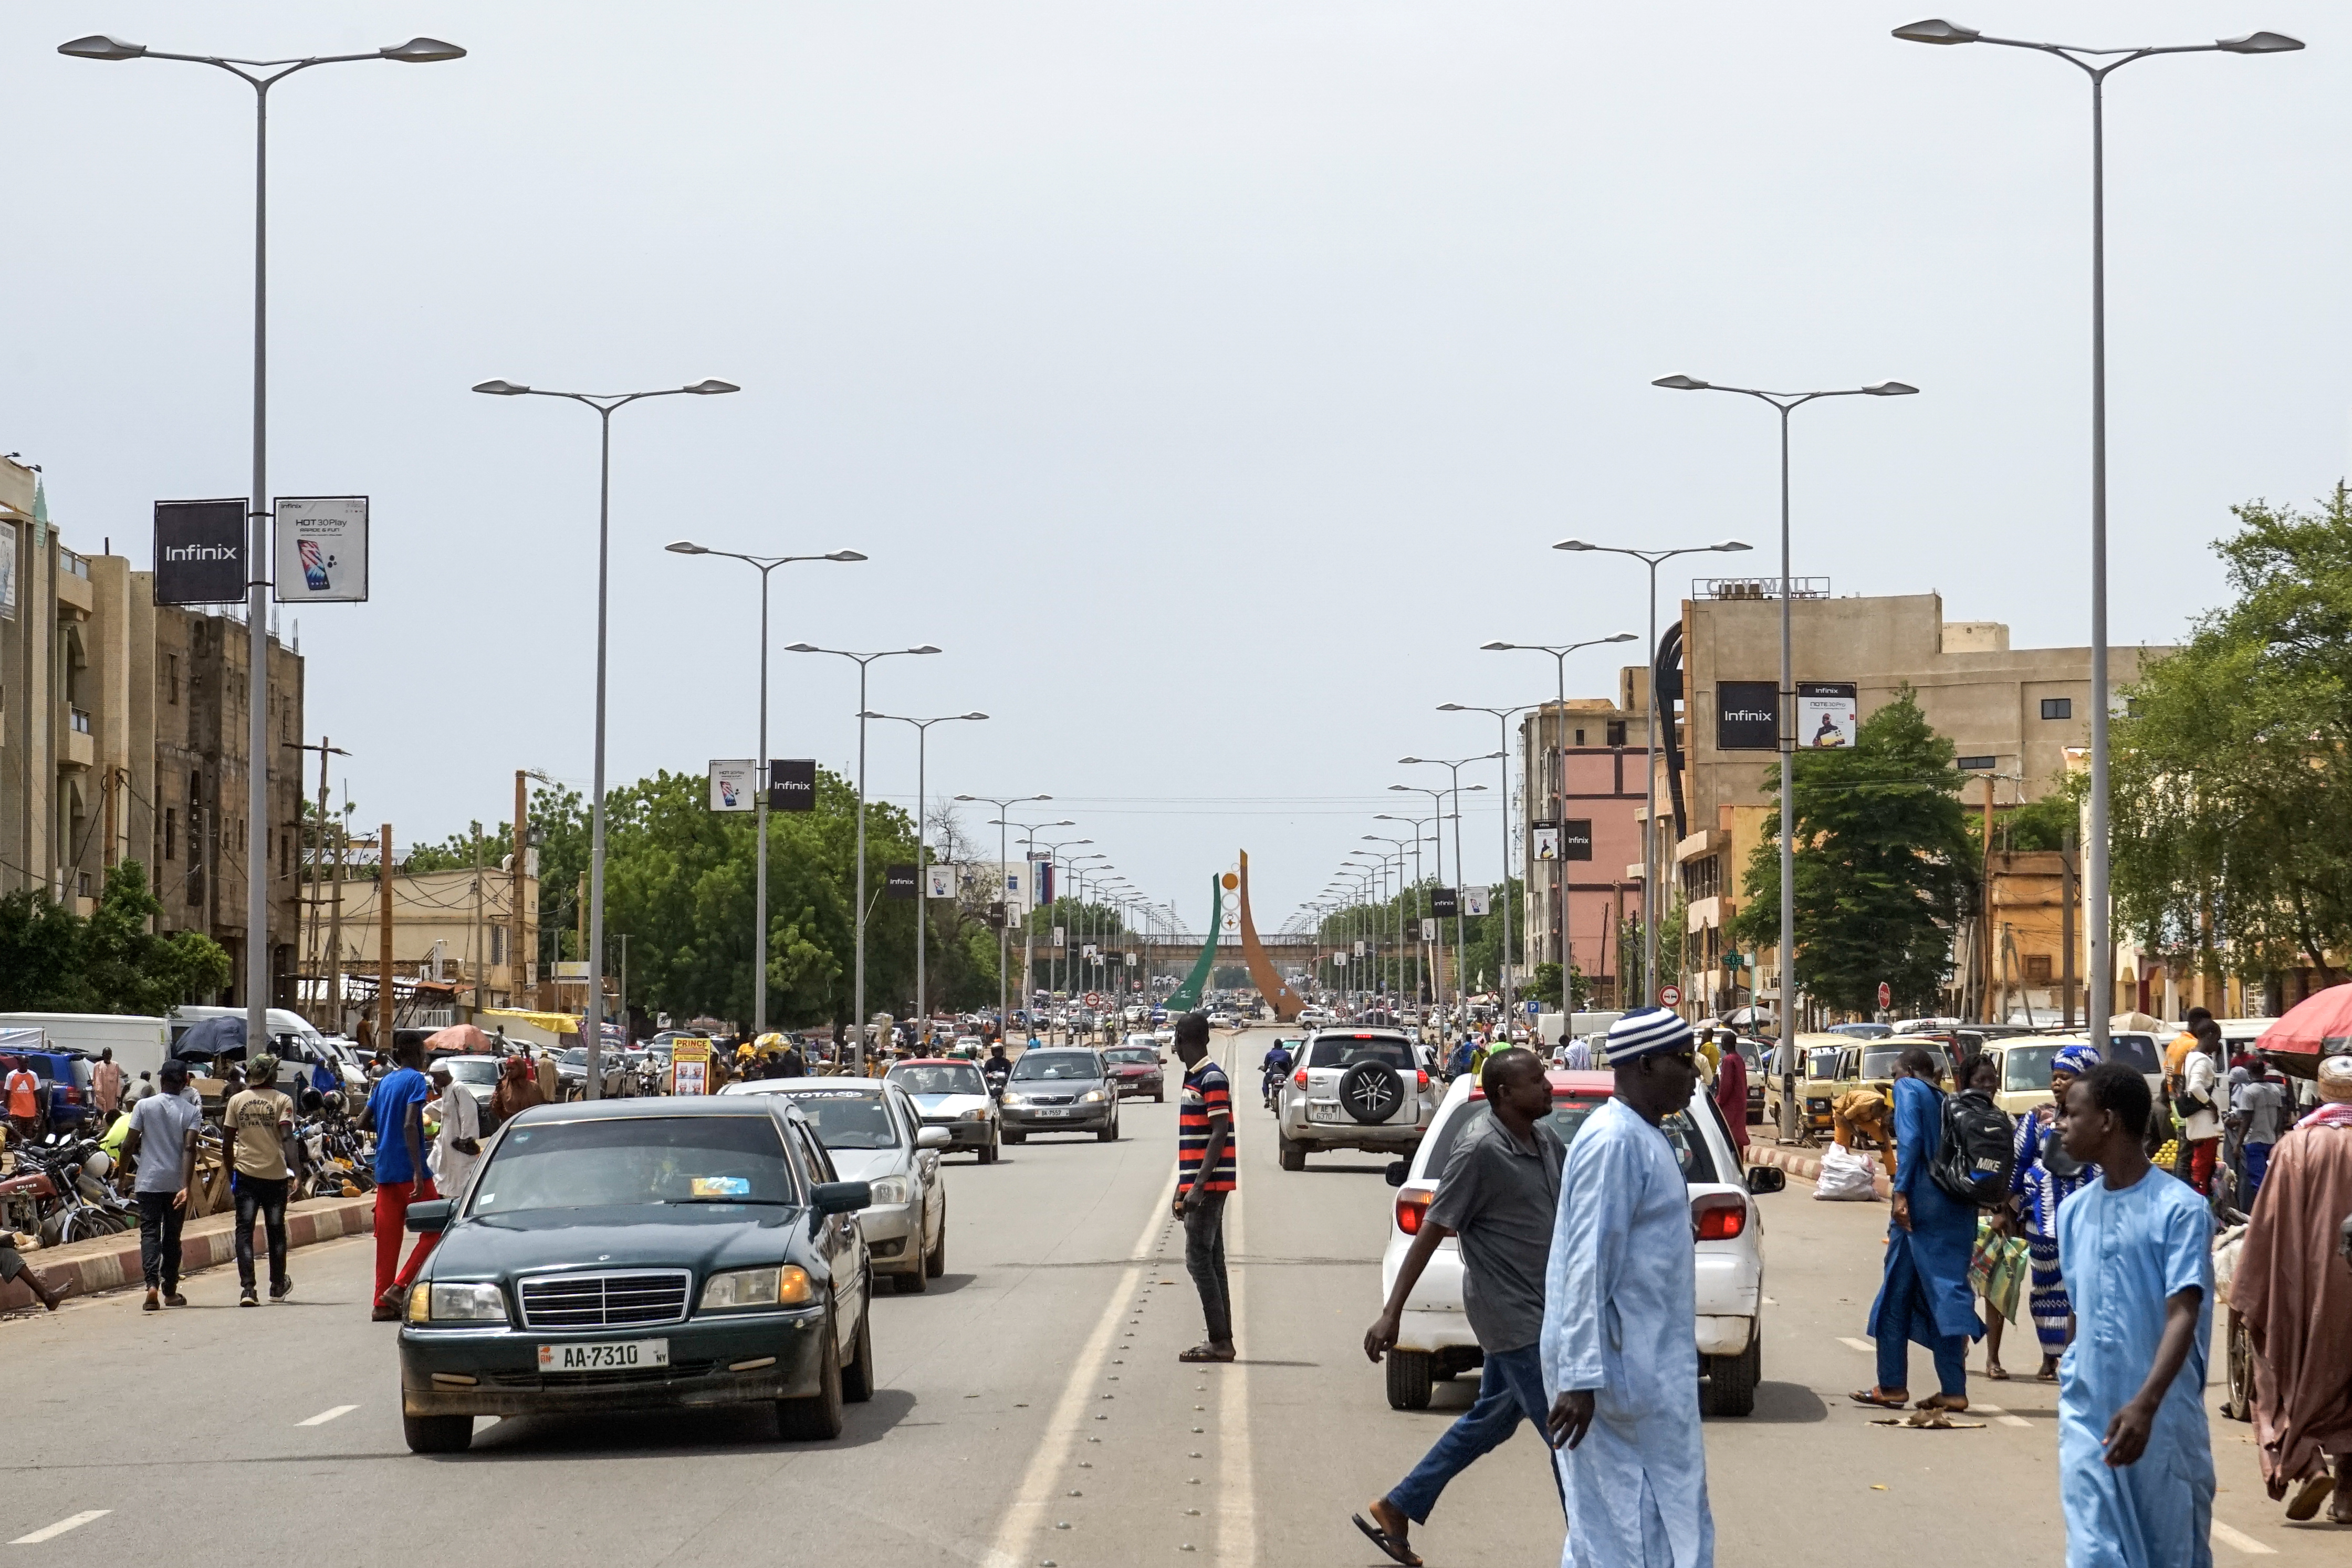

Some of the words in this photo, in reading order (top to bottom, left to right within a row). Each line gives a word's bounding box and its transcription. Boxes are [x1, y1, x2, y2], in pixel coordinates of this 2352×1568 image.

[166, 543, 237, 561] Infinix
[1707, 579, 1752, 594] CITY
[1725, 710, 1772, 721] Infinix
[775, 781, 811, 790] Infinix
